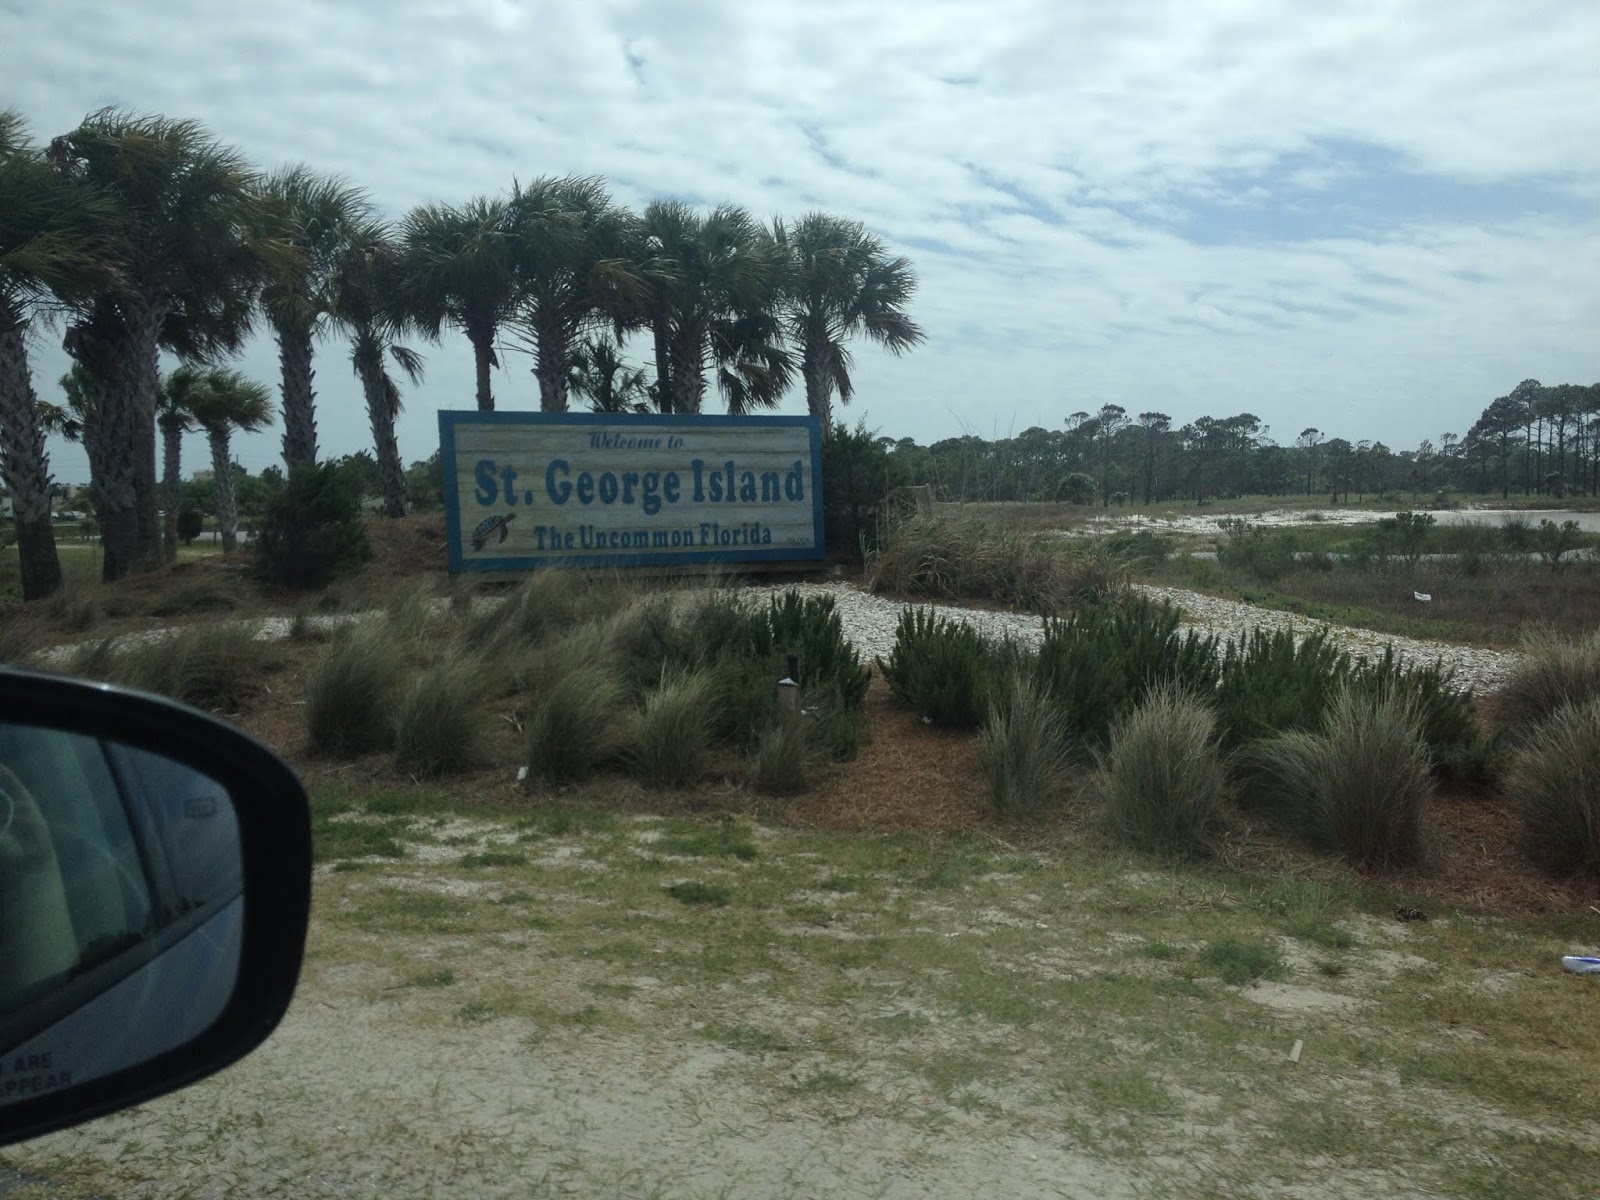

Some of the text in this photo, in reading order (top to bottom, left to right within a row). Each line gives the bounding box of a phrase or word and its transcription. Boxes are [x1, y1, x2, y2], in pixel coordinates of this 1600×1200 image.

[588, 431, 684, 449] Welcome to
[474, 458, 804, 515] St. George Island
[533, 525, 575, 550] The
[579, 525, 694, 549] Uncommon
[699, 522, 772, 546] Florida
[14, 1051, 53, 1073] ARE
